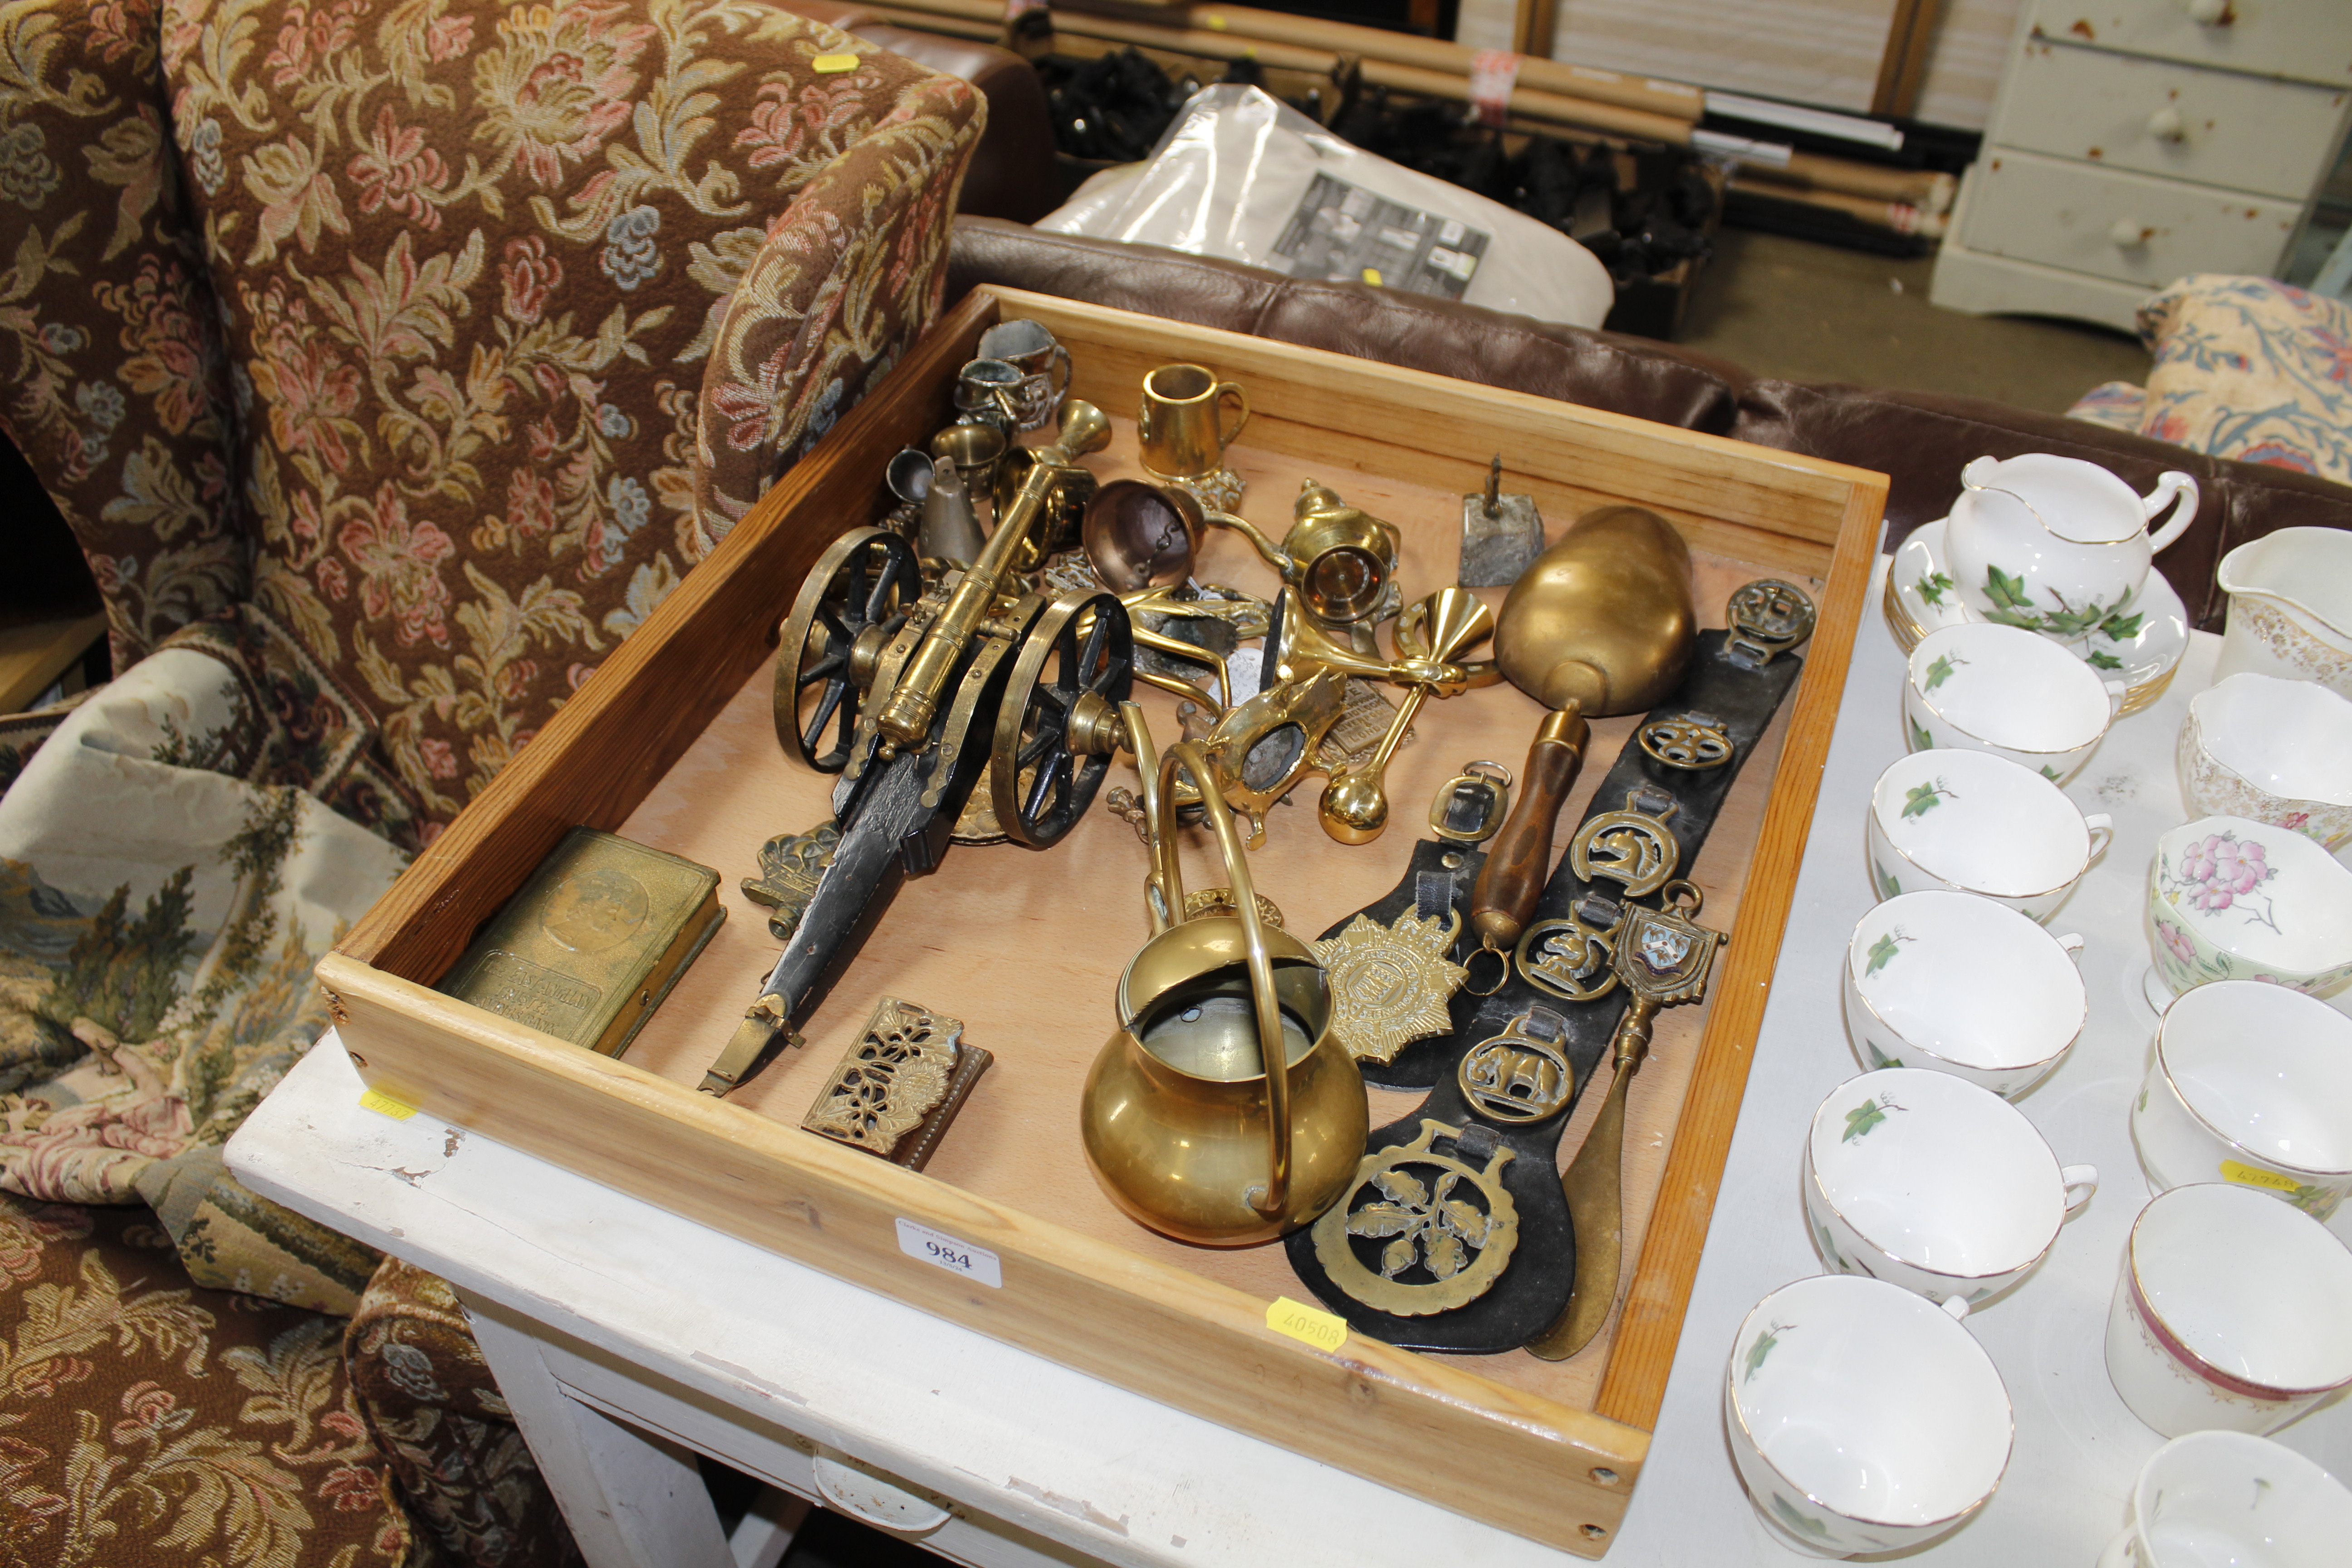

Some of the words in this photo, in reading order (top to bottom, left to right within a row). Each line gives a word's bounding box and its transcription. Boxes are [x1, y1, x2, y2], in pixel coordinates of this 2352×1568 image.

[498, 984, 554, 1016] TRUSTEE
[507, 969, 544, 990] EAST
[537, 980, 592, 1010] ANGLIAN
[522, 1013, 560, 1036] BANK
[370, 1099, 410, 1119] 47737
[898, 1220, 921, 1232] Clarke
[936, 1234, 965, 1249] Simpson
[967, 1247, 997, 1261] Auctions
[926, 1241, 972, 1270] 984
[1283, 1313, 1339, 1344] 40508
